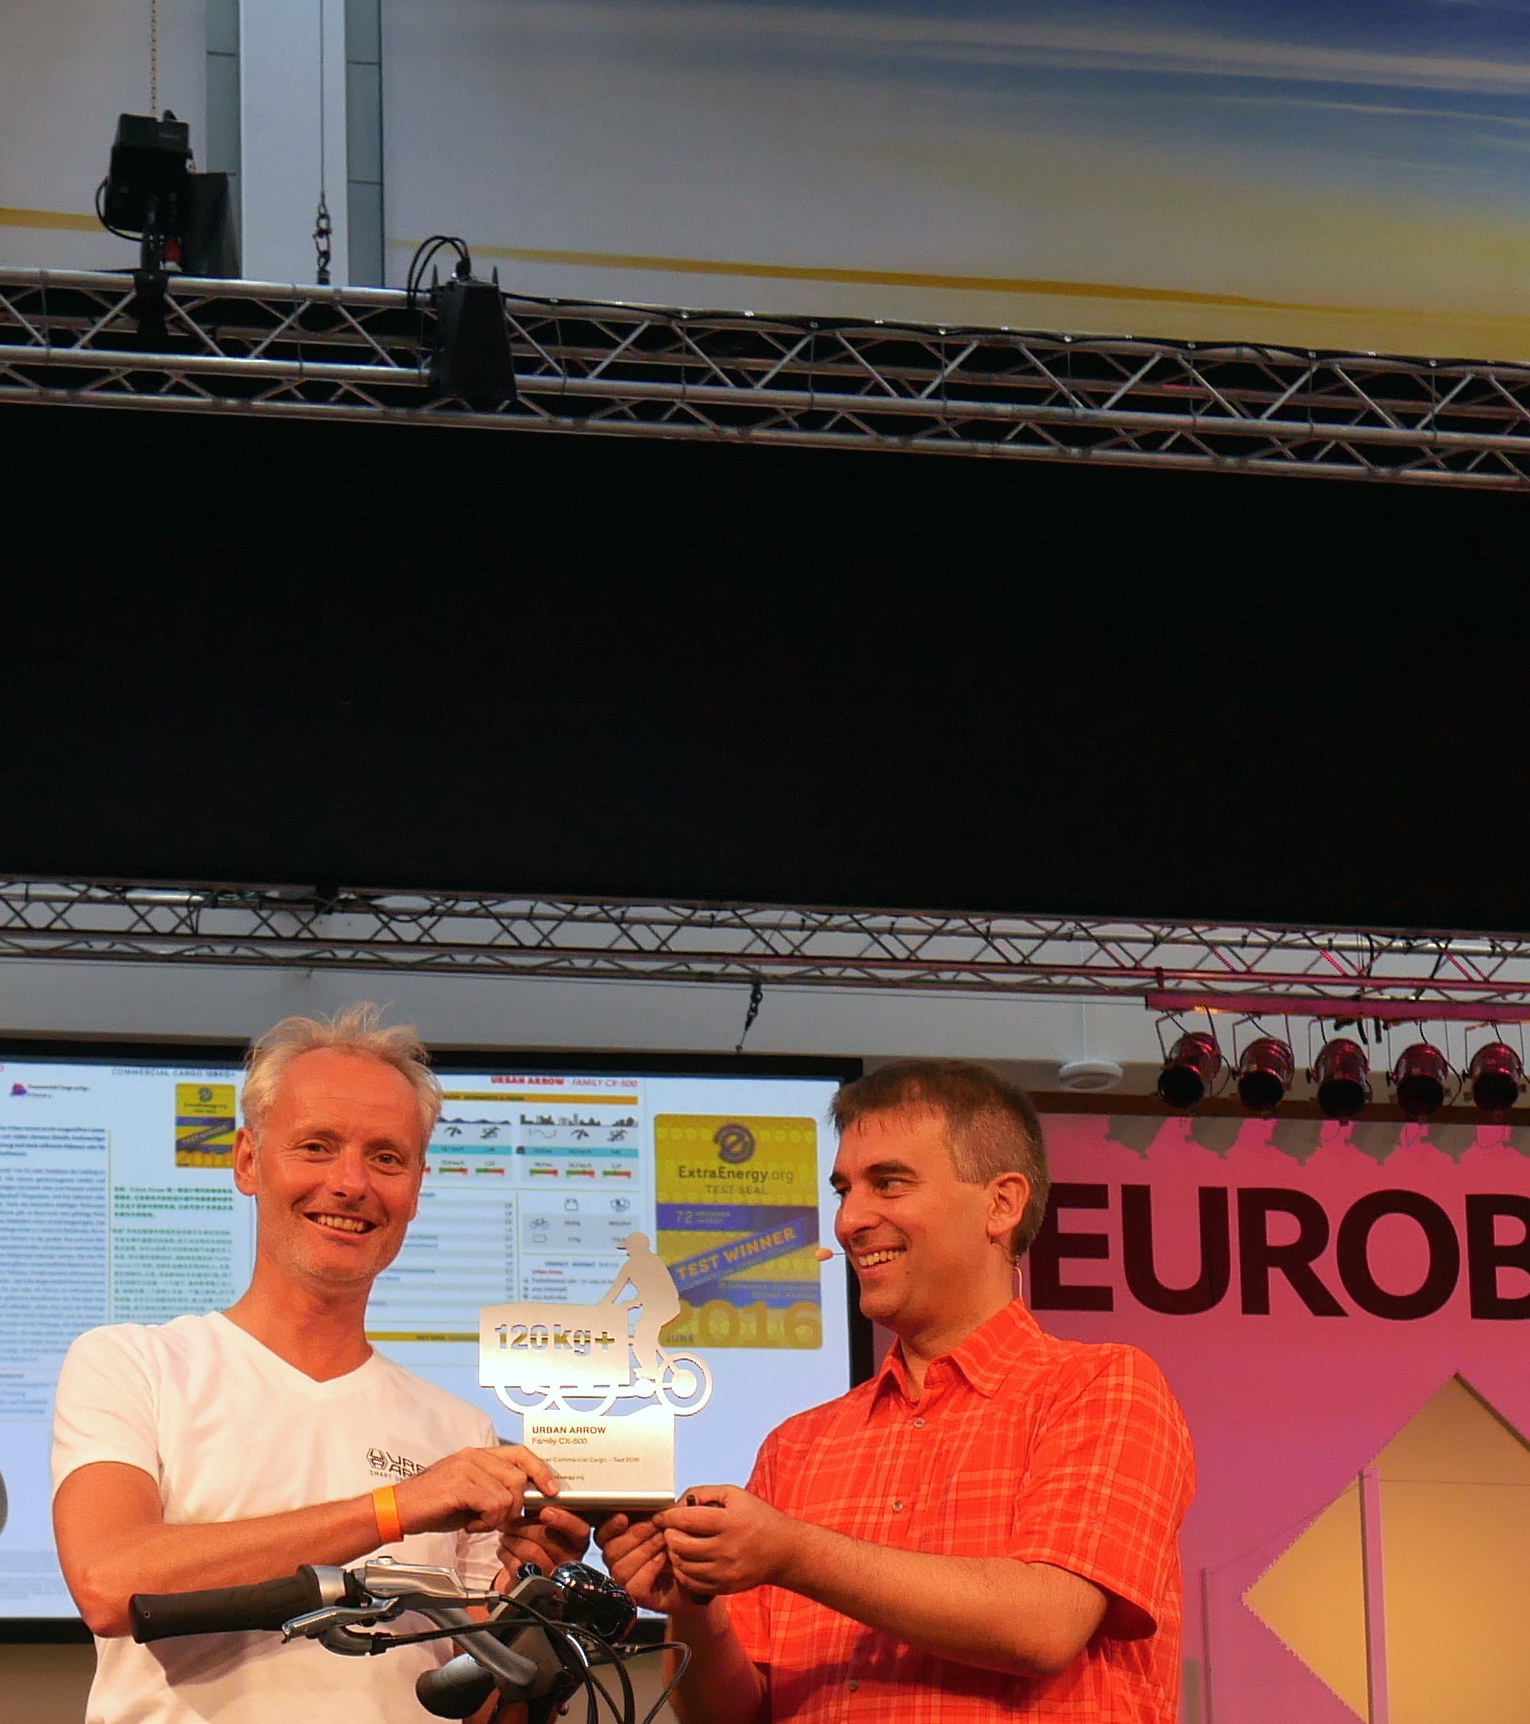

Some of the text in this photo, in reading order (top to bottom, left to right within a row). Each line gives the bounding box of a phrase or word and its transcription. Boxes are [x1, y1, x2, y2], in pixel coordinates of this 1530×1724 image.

[675, 1255, 720, 1280] TEST
[723, 1226, 797, 1262] WINNER
[532, 1426, 607, 1434] URBAN ARROW
